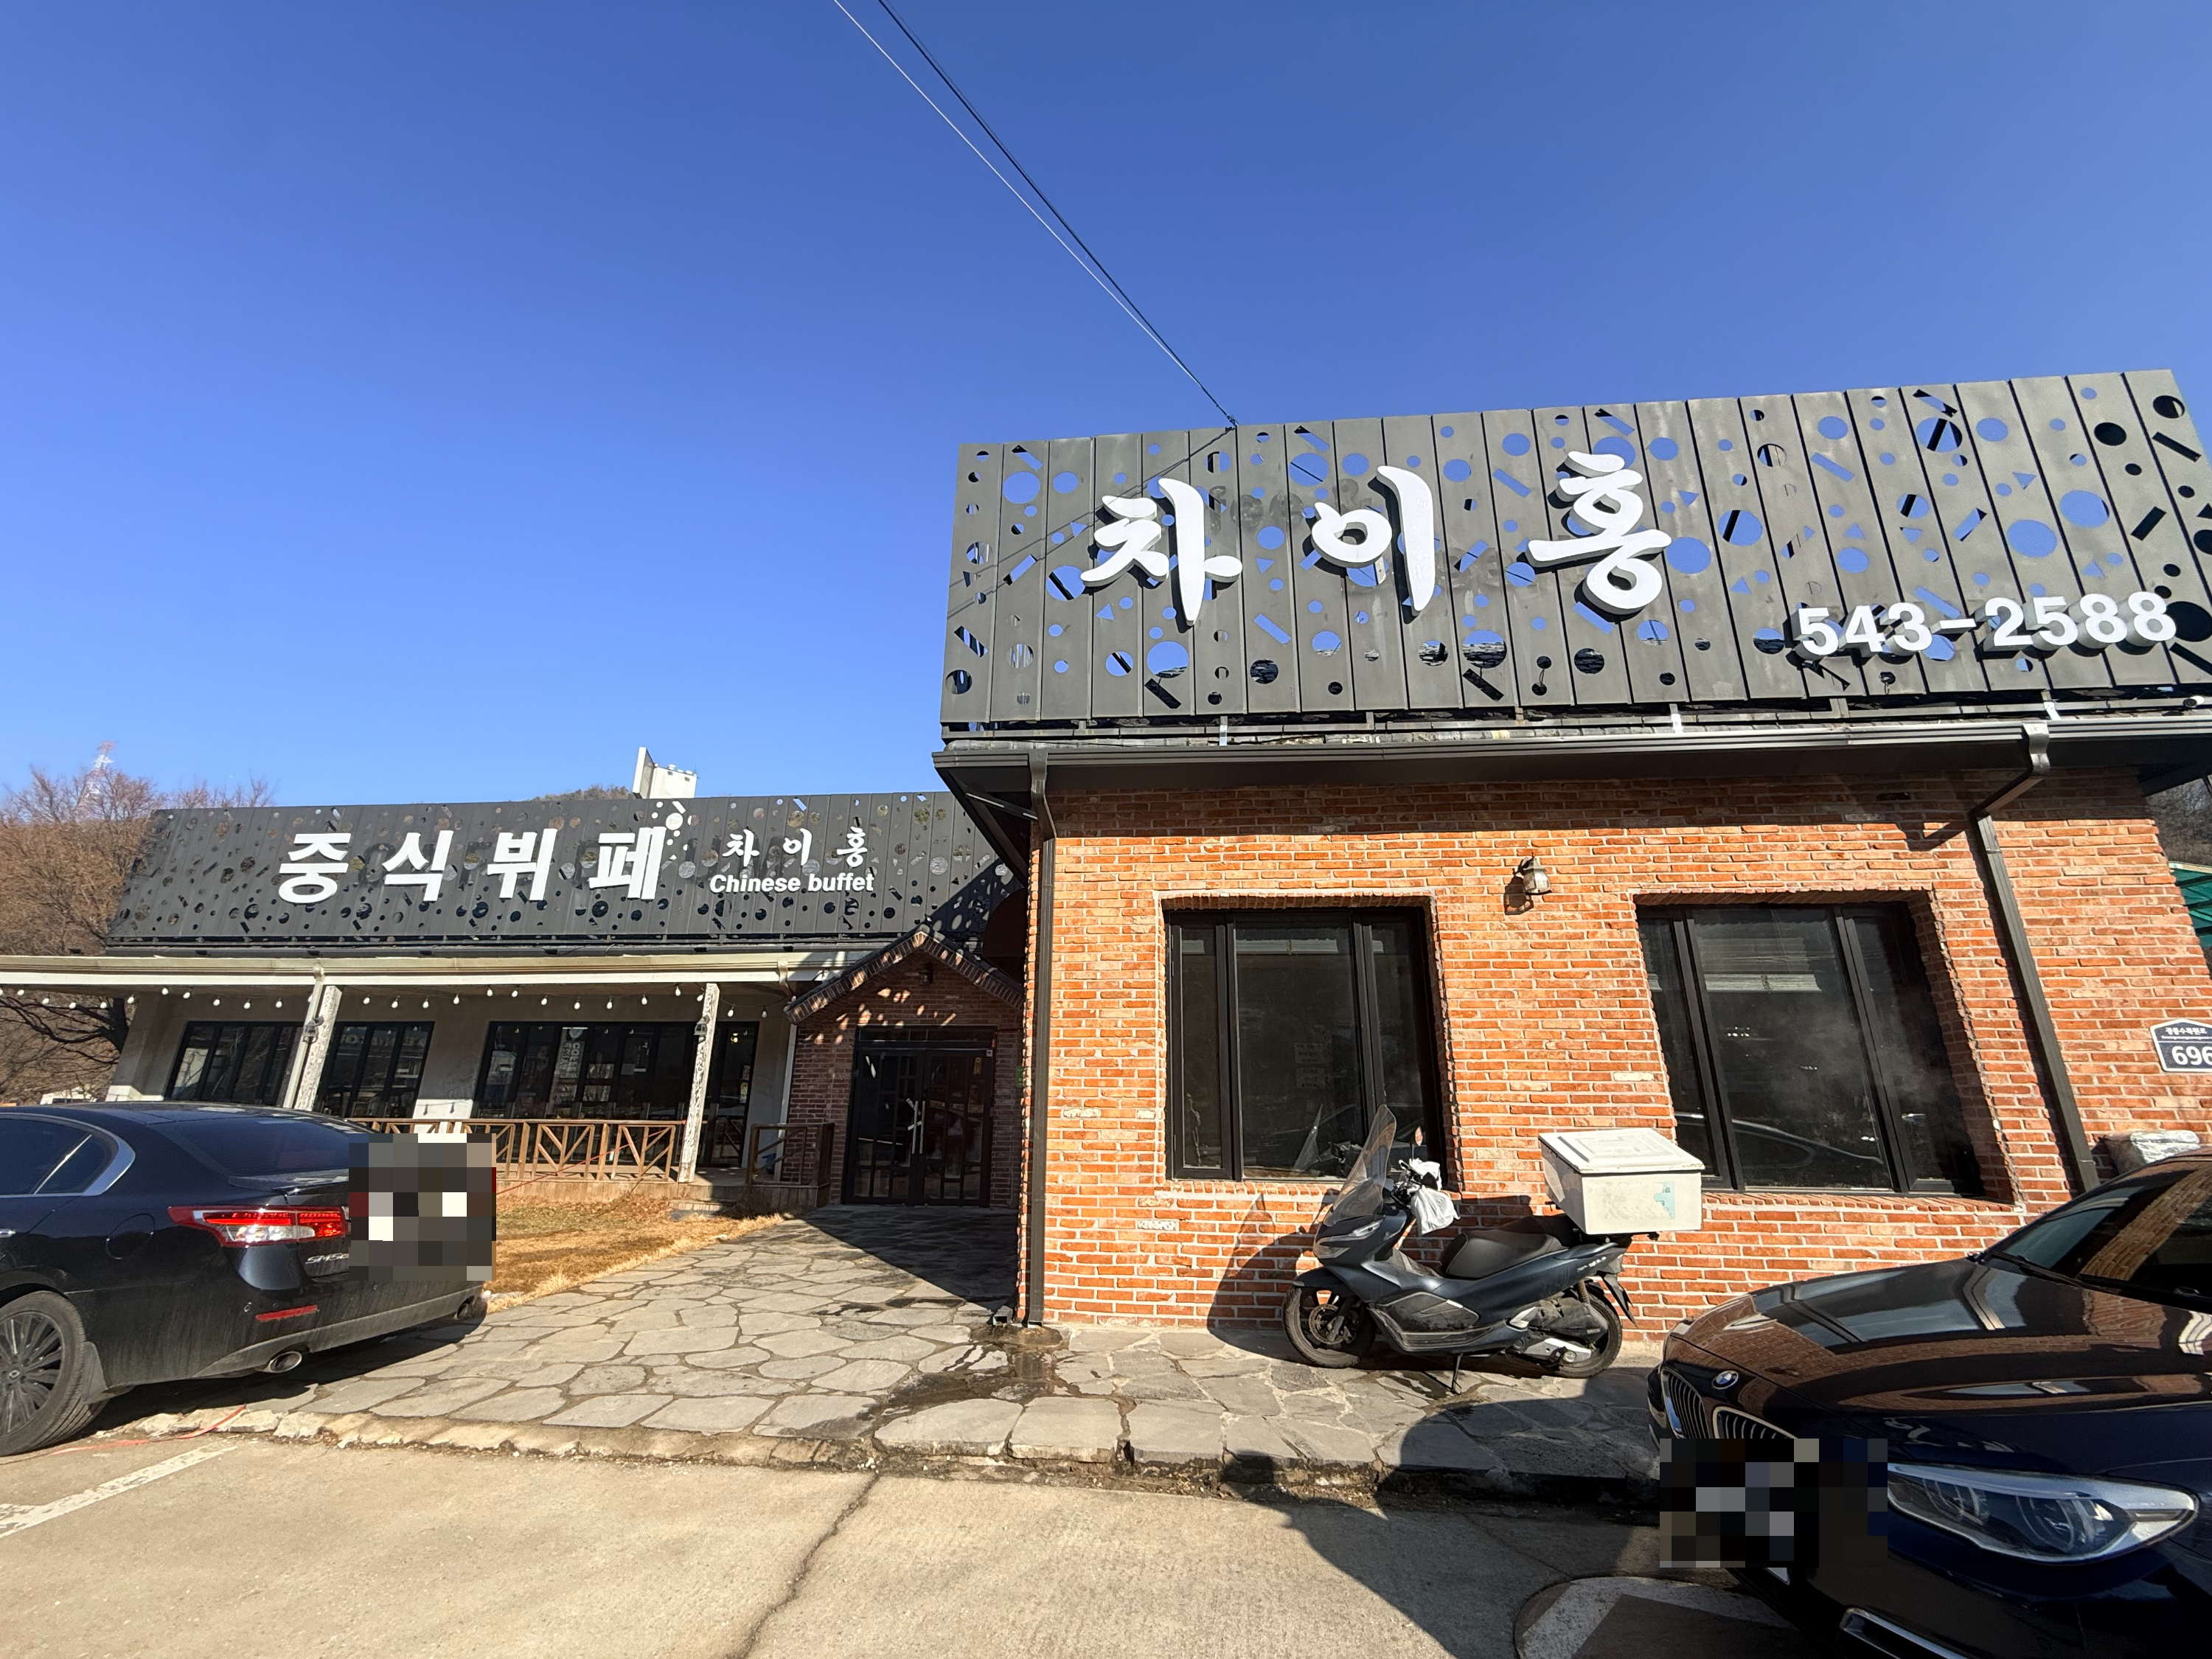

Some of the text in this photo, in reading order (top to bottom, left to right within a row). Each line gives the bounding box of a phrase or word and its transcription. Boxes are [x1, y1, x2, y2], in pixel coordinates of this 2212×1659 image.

[1080, 451, 1672, 626] 차이홍
[1795, 591, 2177, 656] 543-2588
[722, 827, 868, 868] 차이홍
[710, 872, 875, 893] Chinese buffet
[2171, 1046, 2212, 1065] 696
